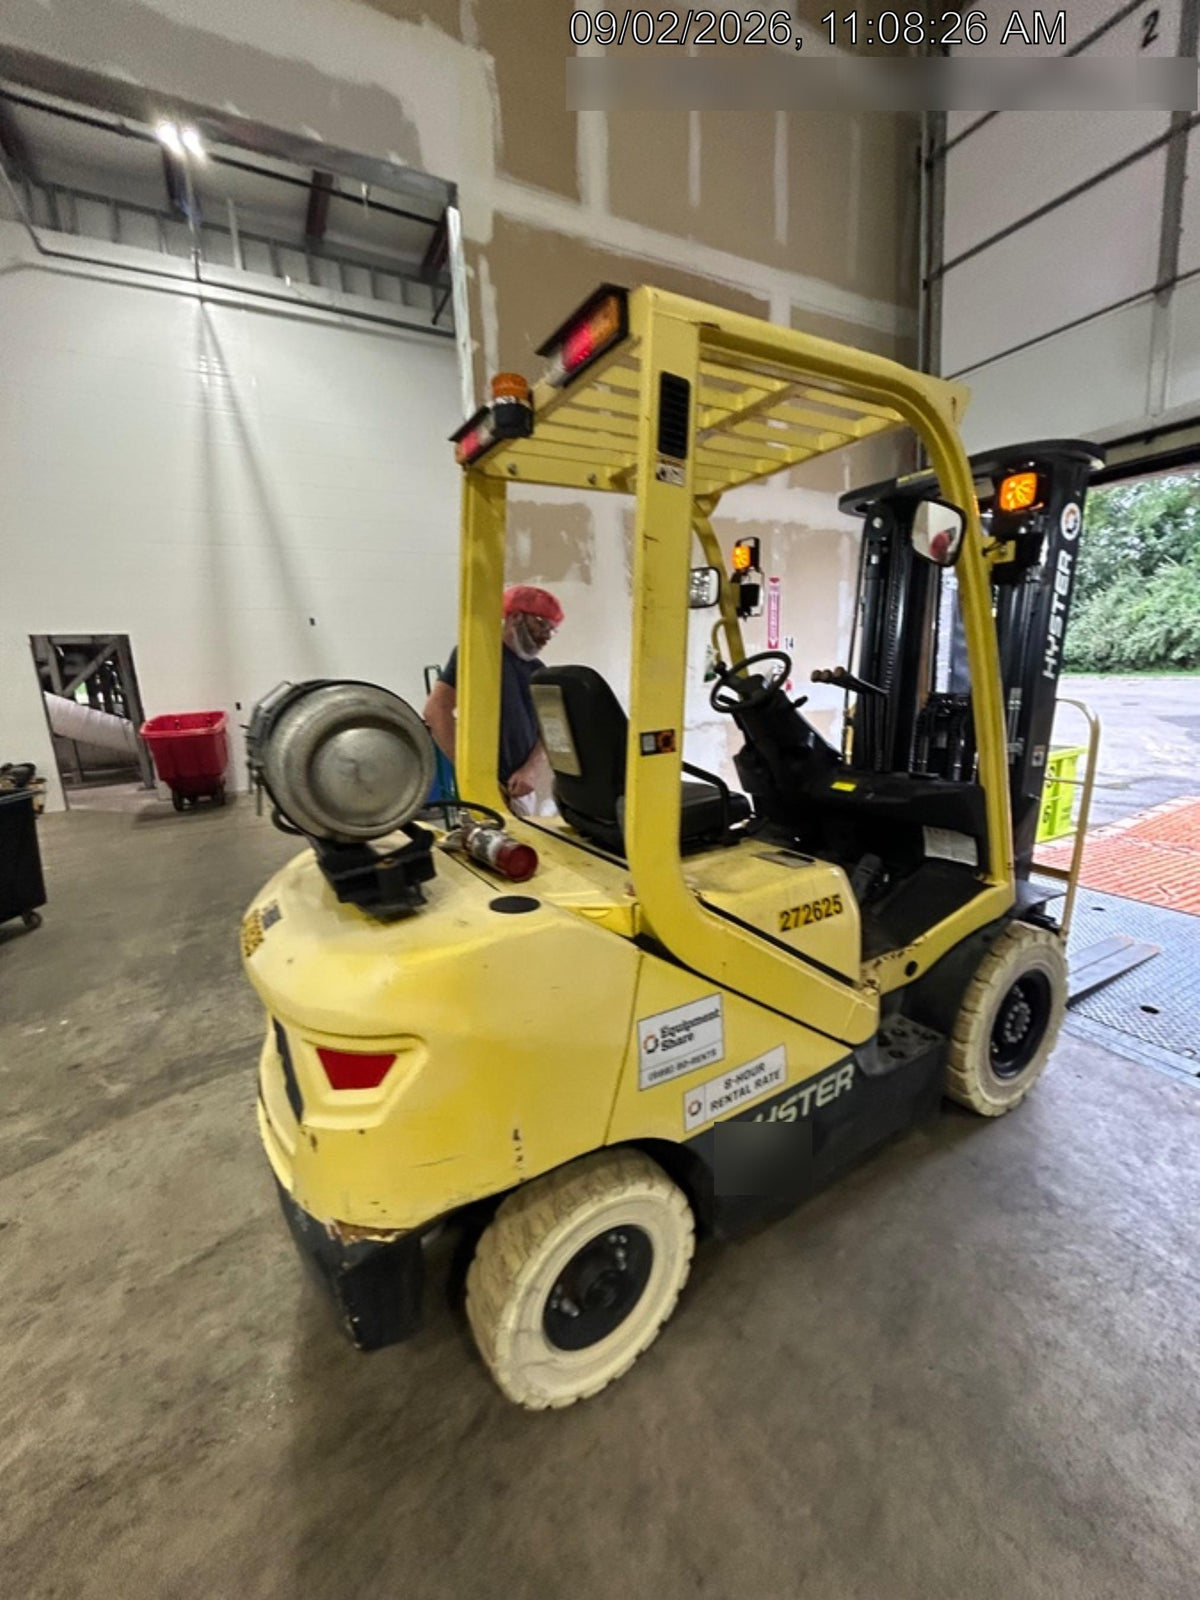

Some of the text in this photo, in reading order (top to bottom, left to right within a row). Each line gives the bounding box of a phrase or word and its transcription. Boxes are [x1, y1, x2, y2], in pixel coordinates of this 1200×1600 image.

[1141, 9, 1159, 48] 2
[1042, 549, 1073, 680] HYSTER
[780, 894, 844, 932] 272625
[660, 1008, 720, 1039] Equipment
[661, 1032, 695, 1052] Share
[710, 1070, 781, 1112] RENTAL RATE
